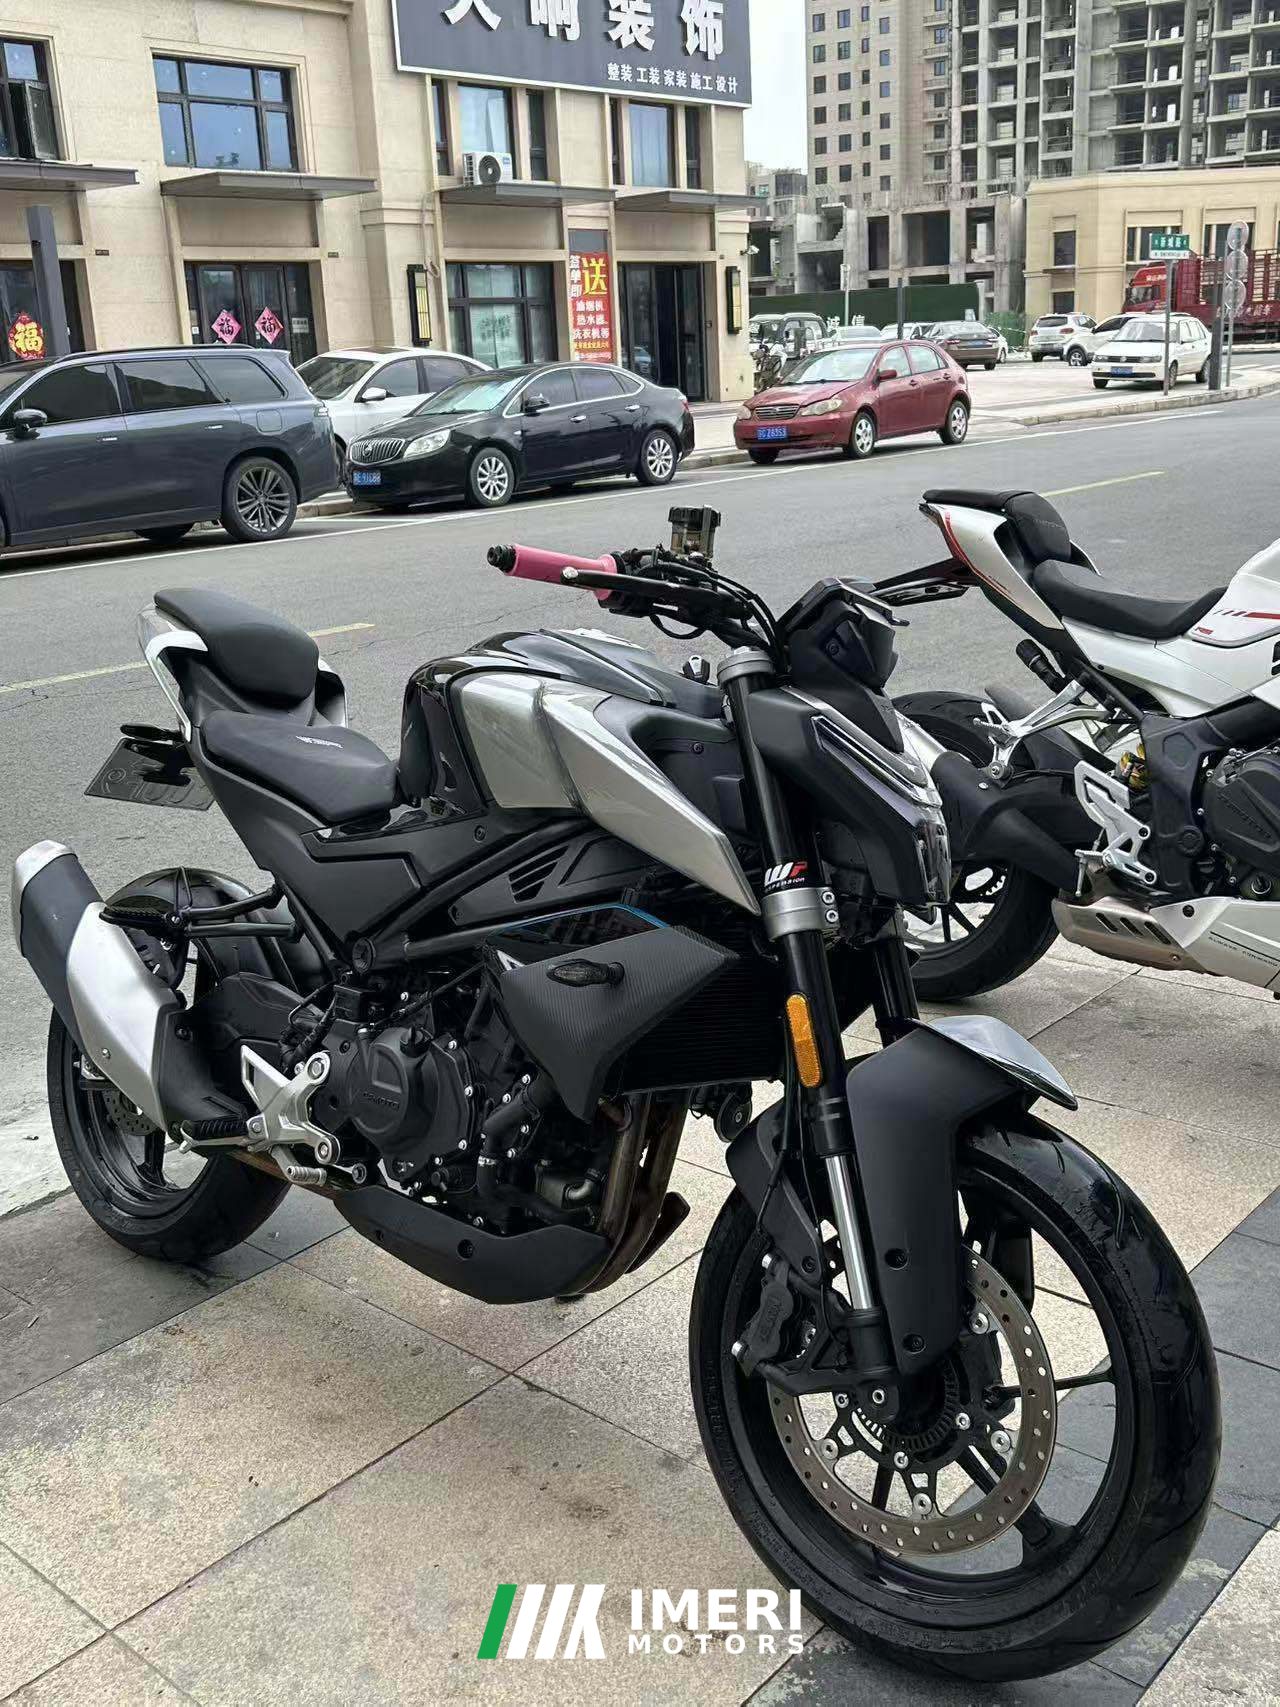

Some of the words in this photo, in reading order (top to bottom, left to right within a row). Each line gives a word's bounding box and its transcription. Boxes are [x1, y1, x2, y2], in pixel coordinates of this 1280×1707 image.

[607, 62, 632, 83] 整装
[637, 66, 660, 86] 工装
[663, 68, 687, 88] 家装
[690, 72, 713, 92] 施工
[716, 75, 738, 95] 设计
[569, 254, 582, 298] 签单即
[581, 257, 608, 295] 送
[14, 321, 43, 352] 福
[218, 317, 234, 336] 福
[260, 316, 276, 334] 福
